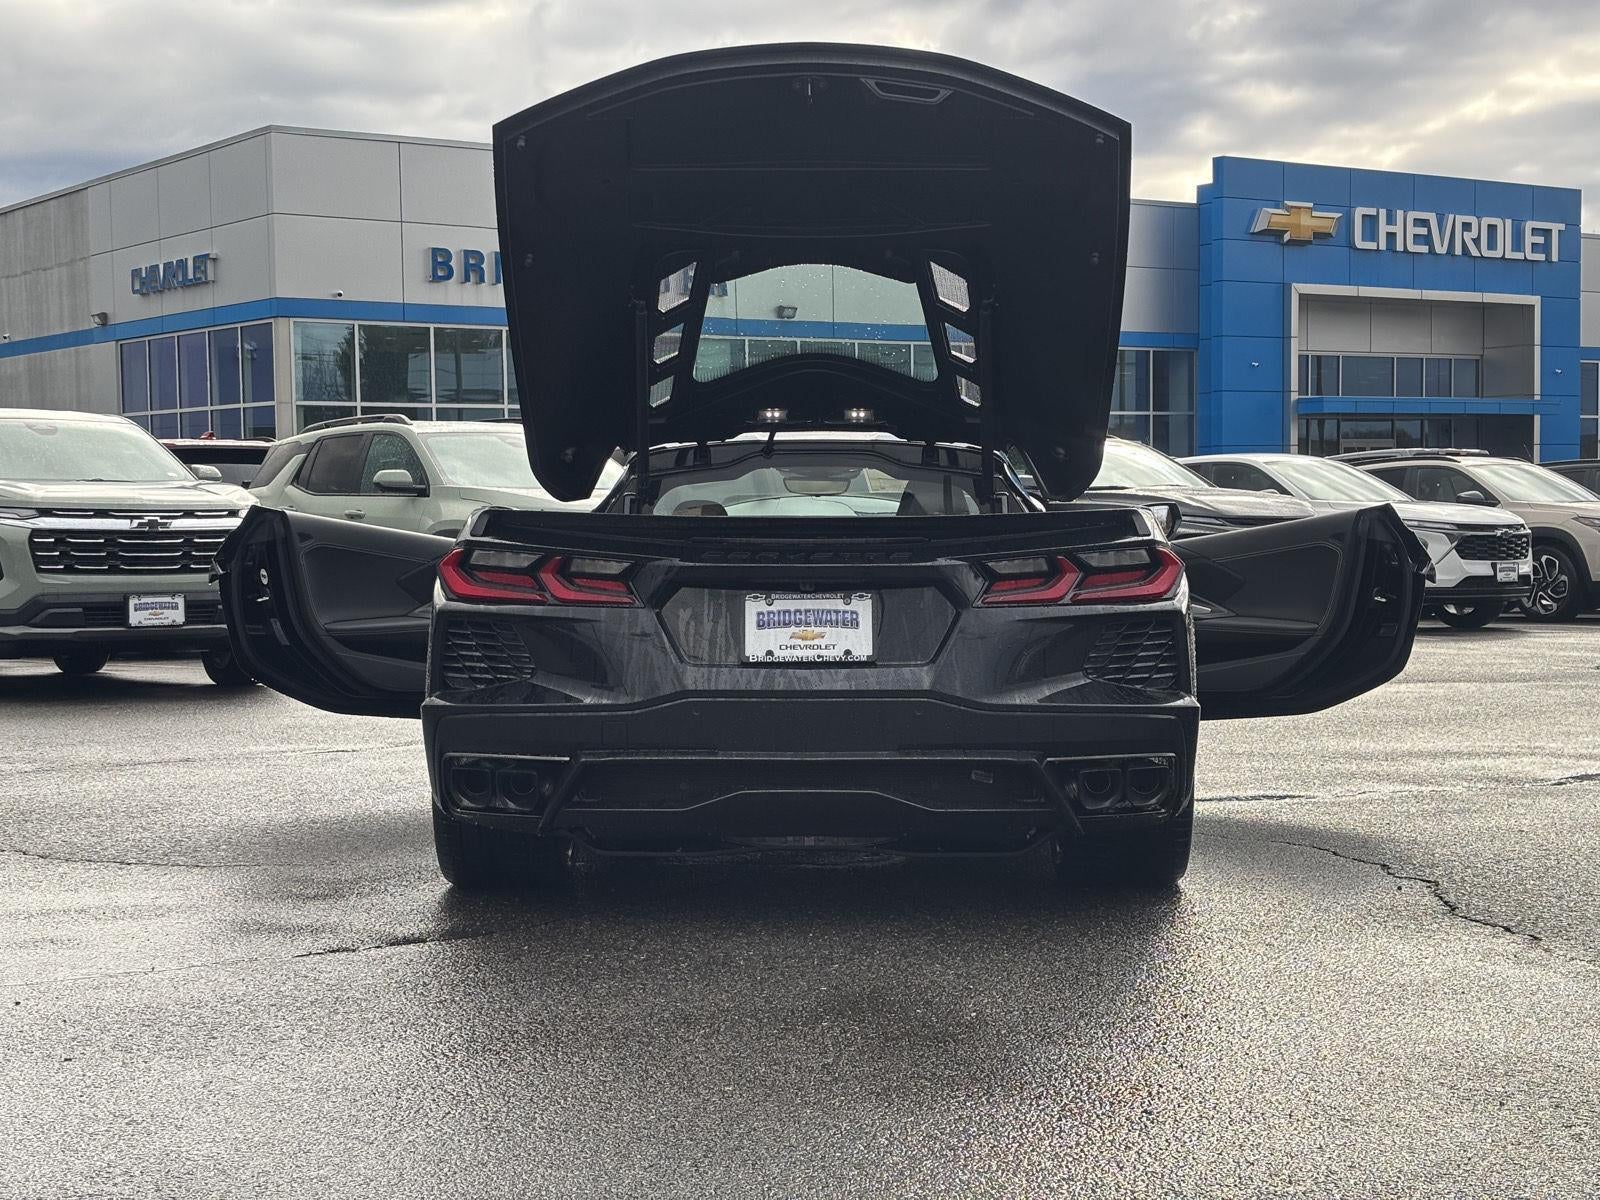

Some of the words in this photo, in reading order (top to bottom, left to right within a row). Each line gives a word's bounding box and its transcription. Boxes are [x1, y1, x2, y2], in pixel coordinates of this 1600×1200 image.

[1354, 207, 1566, 262] CHEVROLET
[131, 253, 209, 295] CHEVROLET
[701, 551, 913, 561] CORVETTE
[756, 609, 860, 630] BRIDGEWATER
[779, 643, 837, 651] CHEVROLET
